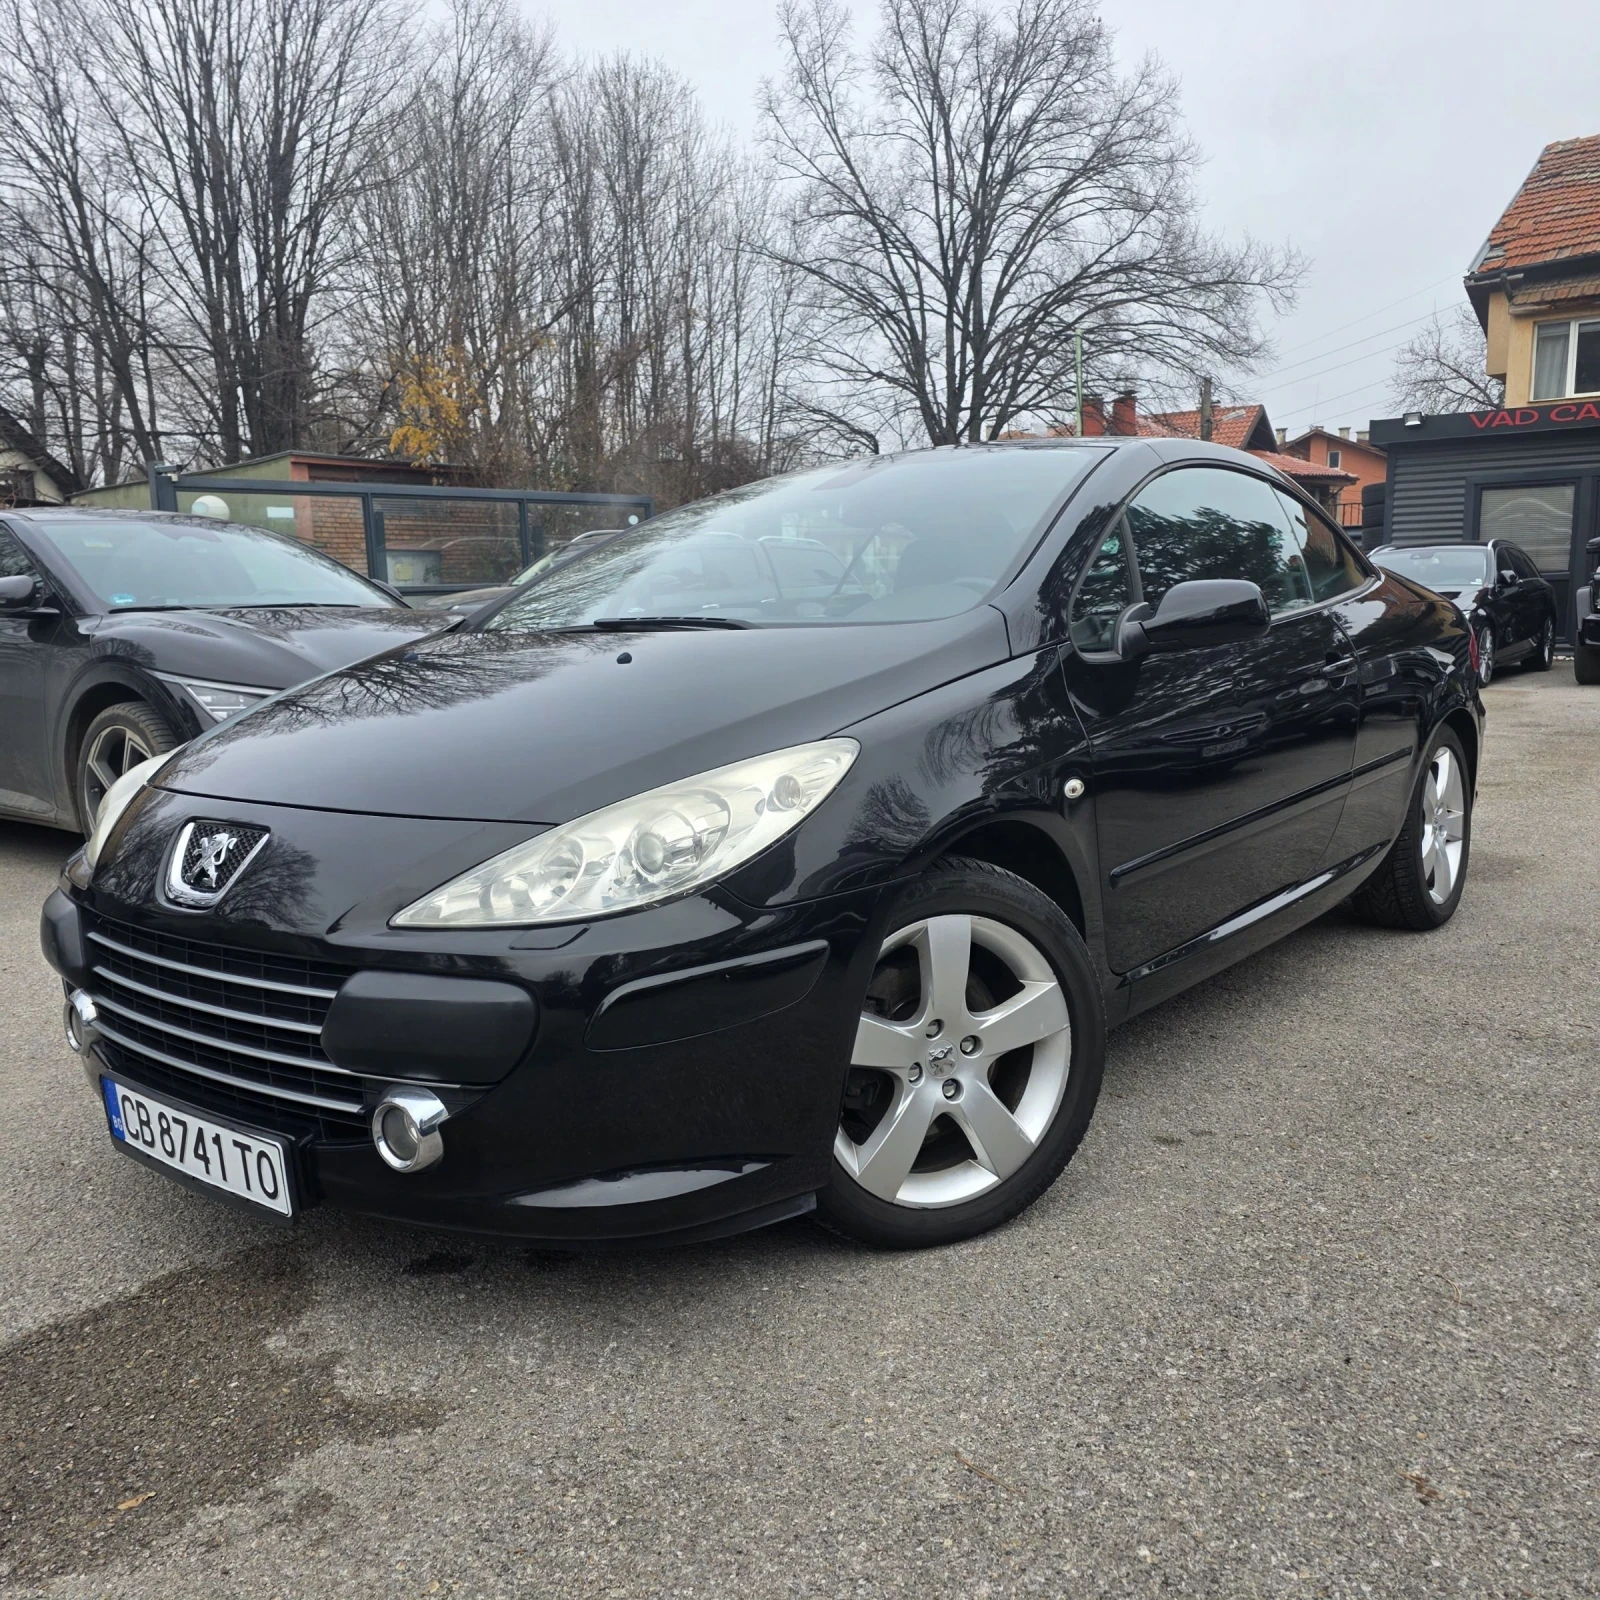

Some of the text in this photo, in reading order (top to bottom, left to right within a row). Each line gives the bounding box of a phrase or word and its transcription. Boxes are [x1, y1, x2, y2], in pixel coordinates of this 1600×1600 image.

[1469, 403, 1600, 429] VAD CA
[112, 1114, 124, 1132] BG
[121, 1094, 156, 1148] CB
[158, 1111, 228, 1182] 8741
